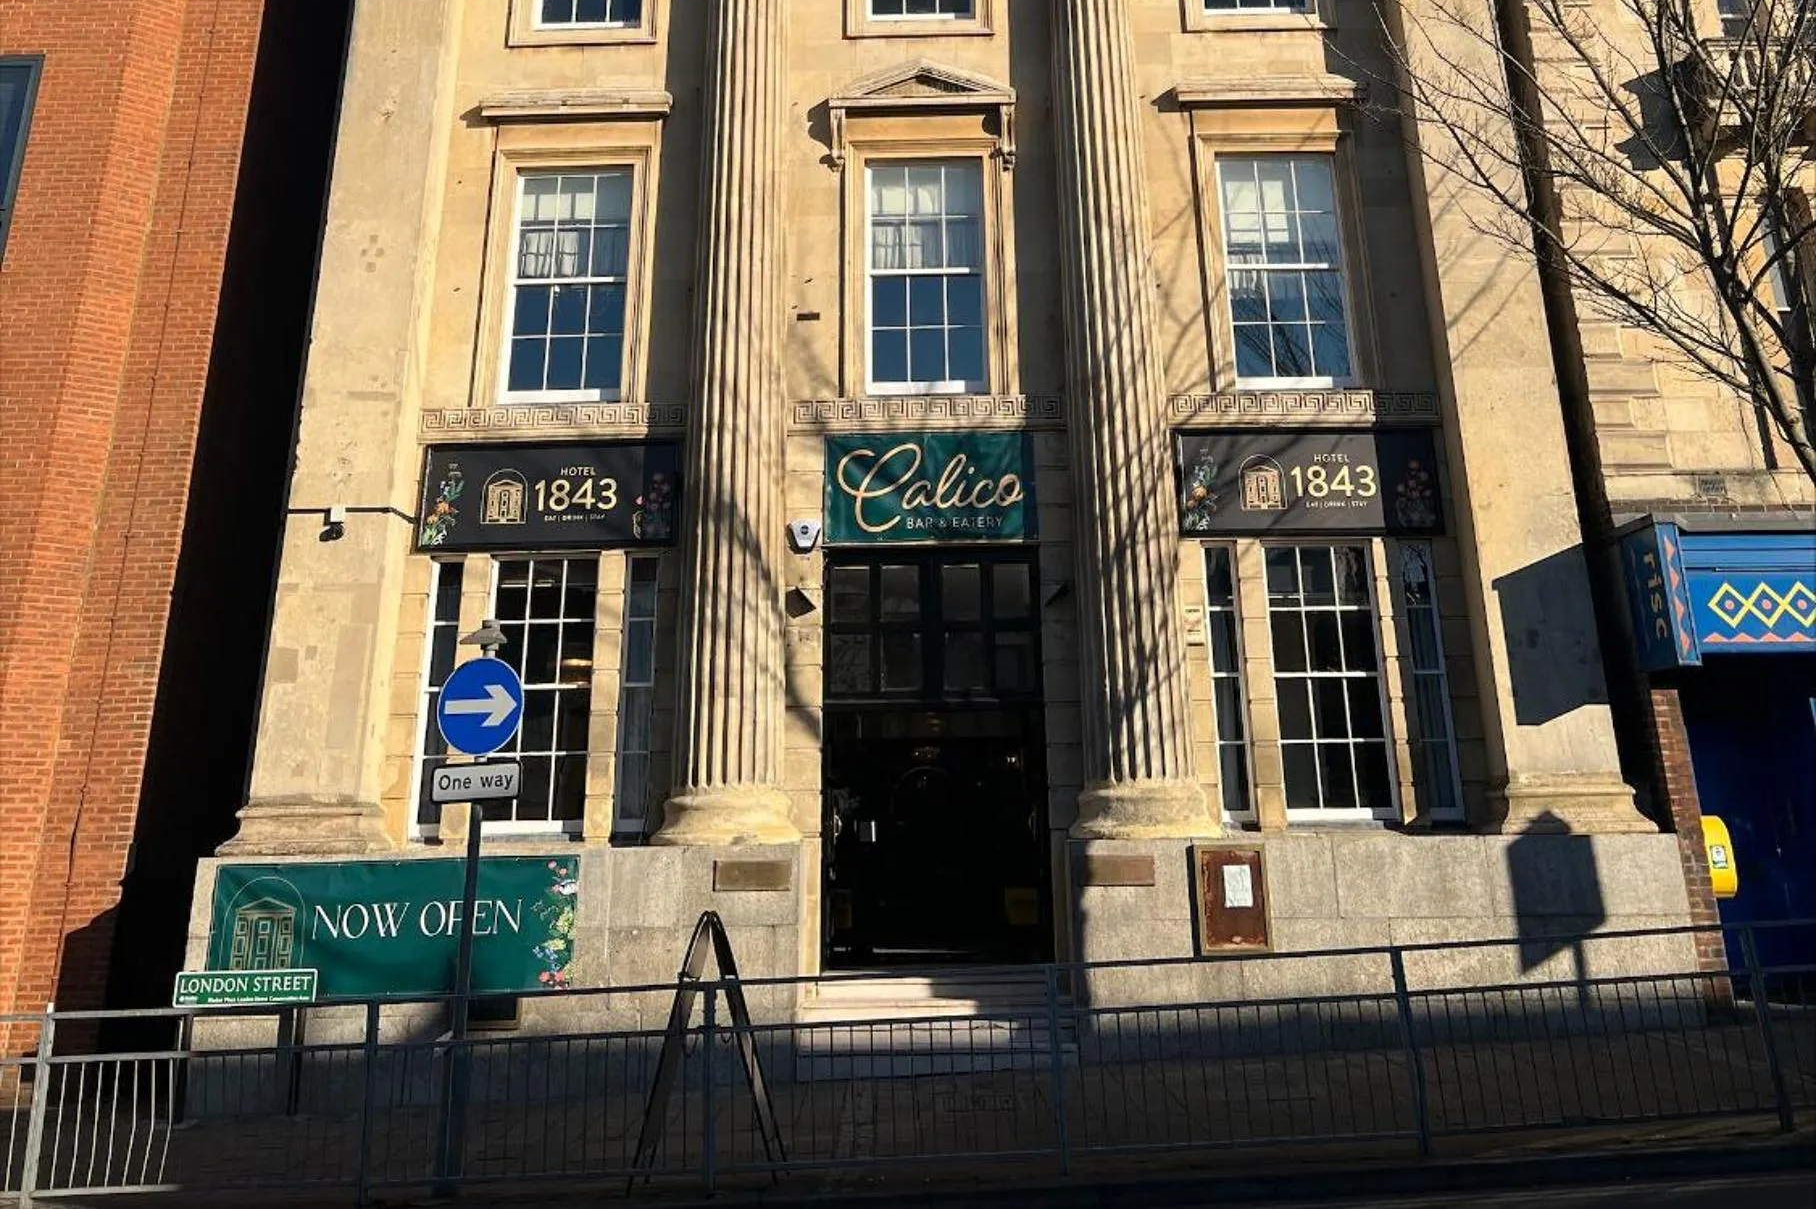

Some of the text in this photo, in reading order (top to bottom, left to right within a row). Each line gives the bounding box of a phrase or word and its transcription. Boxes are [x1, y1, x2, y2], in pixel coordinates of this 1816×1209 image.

[1313, 453, 1350, 463] HOTEL
[560, 466, 597, 476] HOTEL
[837, 442, 1024, 533] Calico
[1291, 465, 1377, 498] 1843
[534, 478, 617, 511] 1843
[906, 516, 1003, 529] BAR & EATERY
[438, 772, 514, 791] One way
[312, 902, 411, 940] NOW
[180, 975, 312, 994] LONDON STREET
